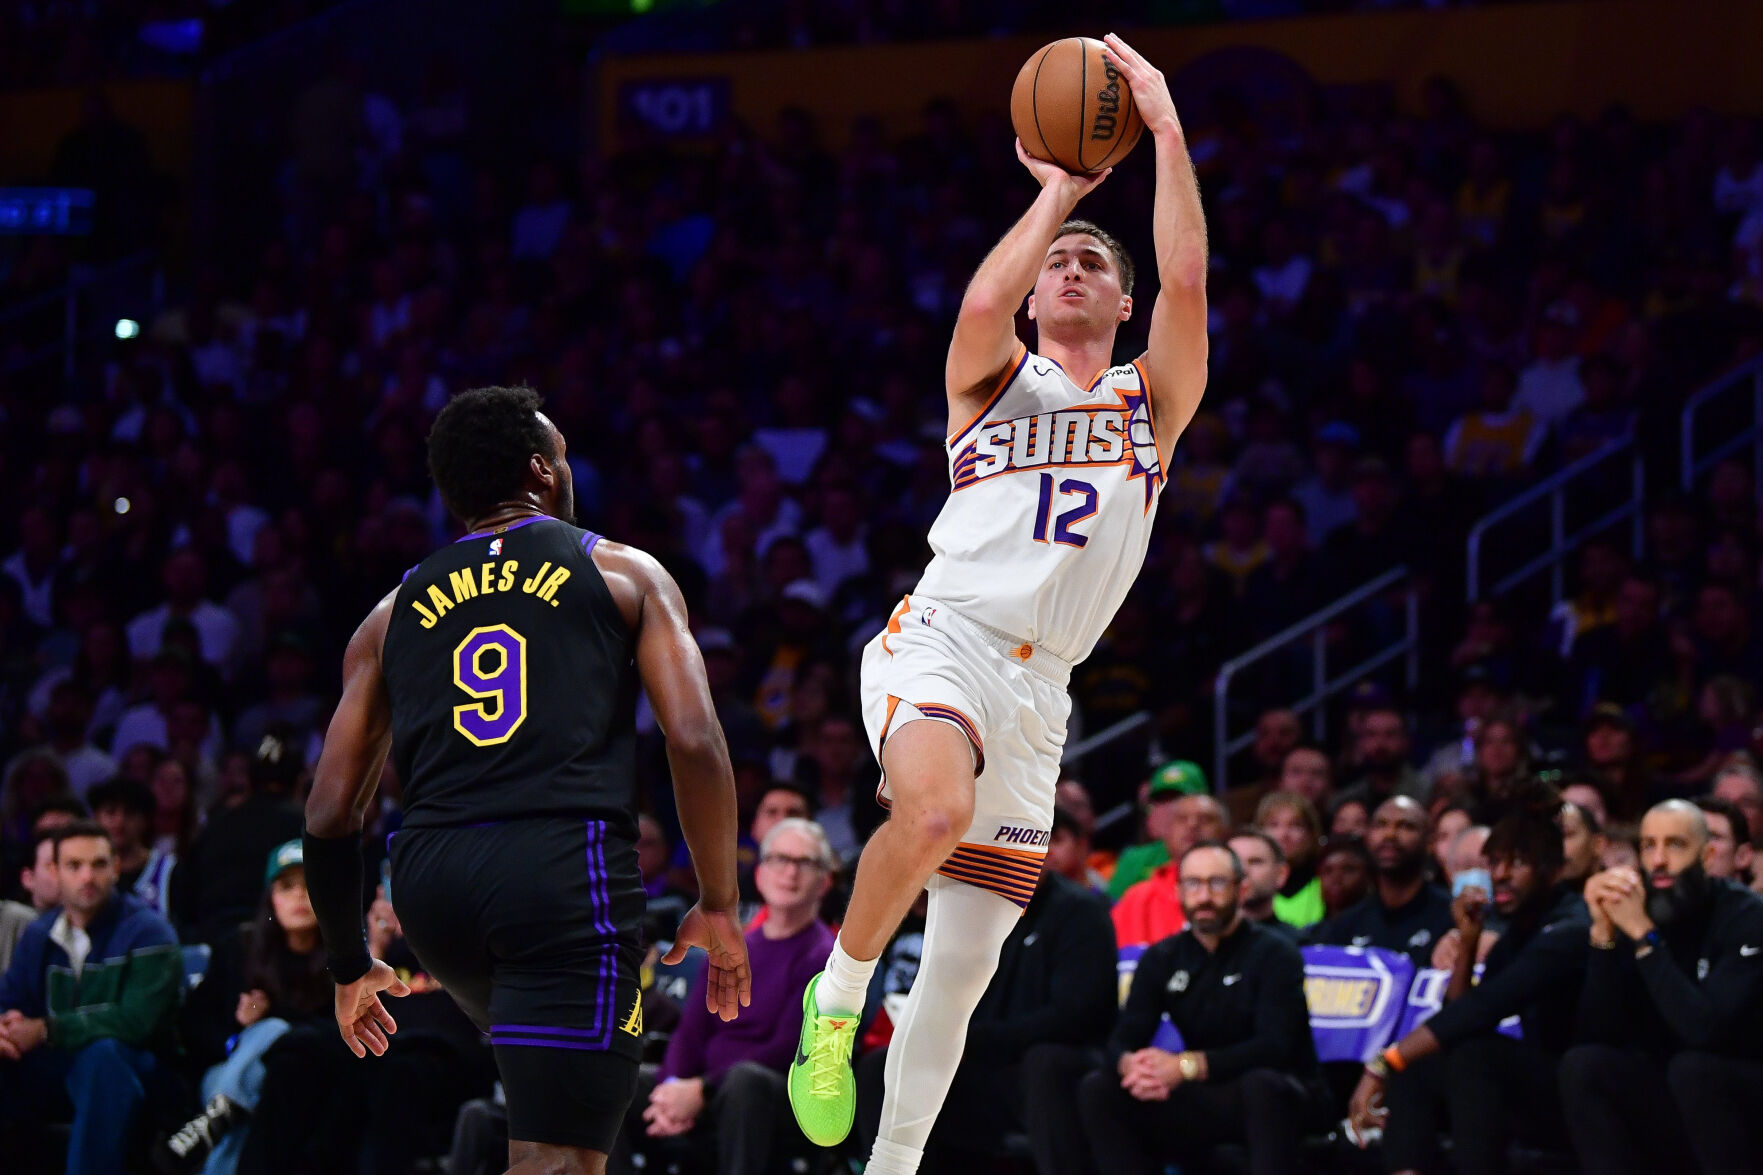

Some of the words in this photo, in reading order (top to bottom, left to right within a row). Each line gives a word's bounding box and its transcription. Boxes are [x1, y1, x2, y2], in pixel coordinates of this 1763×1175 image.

[975, 411, 1124, 479] SUNS
[1033, 472, 1099, 550] 12
[411, 559, 519, 630] JAMES
[522, 561, 571, 608] JR.
[453, 623, 527, 747] 9
